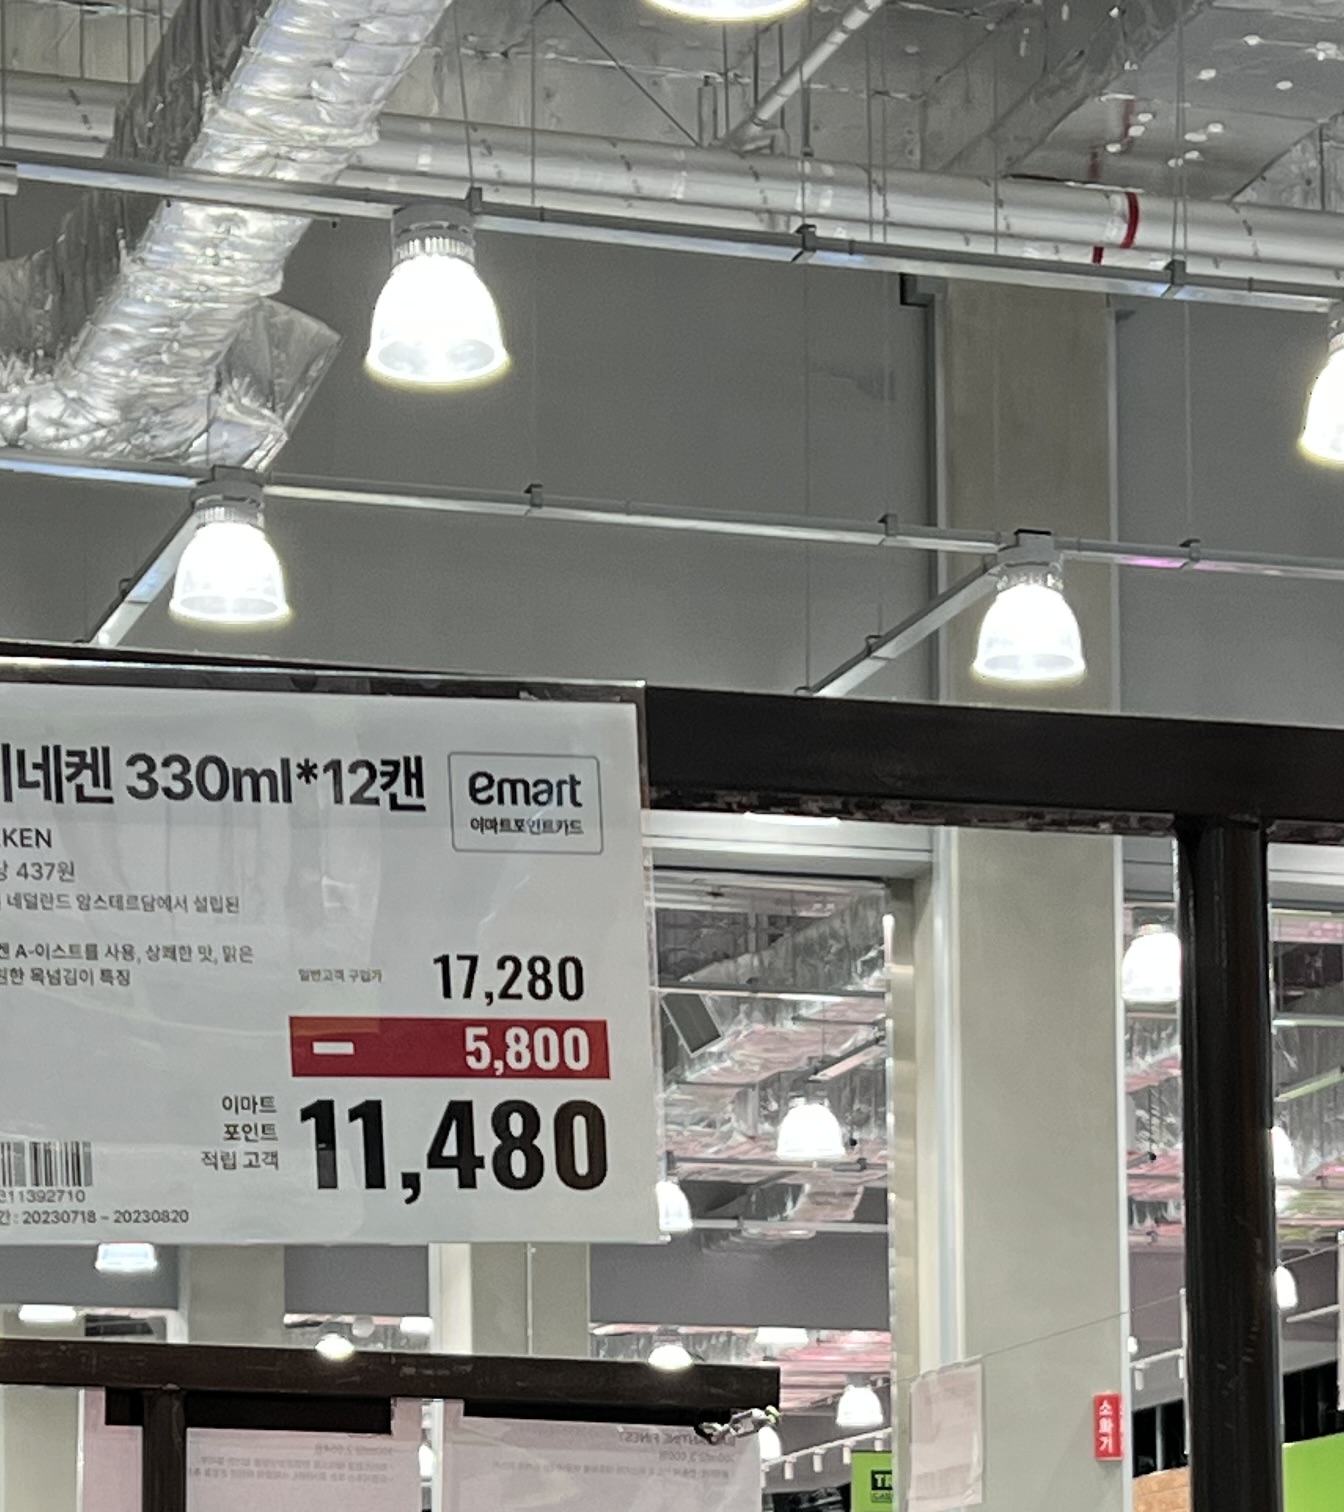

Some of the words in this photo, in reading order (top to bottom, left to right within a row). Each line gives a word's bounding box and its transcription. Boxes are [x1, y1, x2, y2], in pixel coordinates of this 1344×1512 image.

[468, 771, 583, 808] emart
[16, 861, 76, 883] 437원
[7, 893, 72, 911] 네덜란드
[77, 894, 188, 912] 암스테르담에서
[193, 895, 240, 914] 설립된
[30, 968, 94, 986] 목넘김이
[100, 969, 131, 986] 특징
[433, 954, 585, 1006] 17,280
[464, 1027, 590, 1076] 5,800
[222, 1096, 277, 1114] 이마트
[223, 1123, 278, 1142] 포인트
[201, 1151, 237, 1170] 적립
[243, 1151, 279, 1170] 고객
[300, 1097, 608, 1204] 11,480
[22, 1210, 97, 1225] 20230718
[113, 1210, 189, 1225] 20230820
[1099, 1401, 1113, 1452] 소화기
